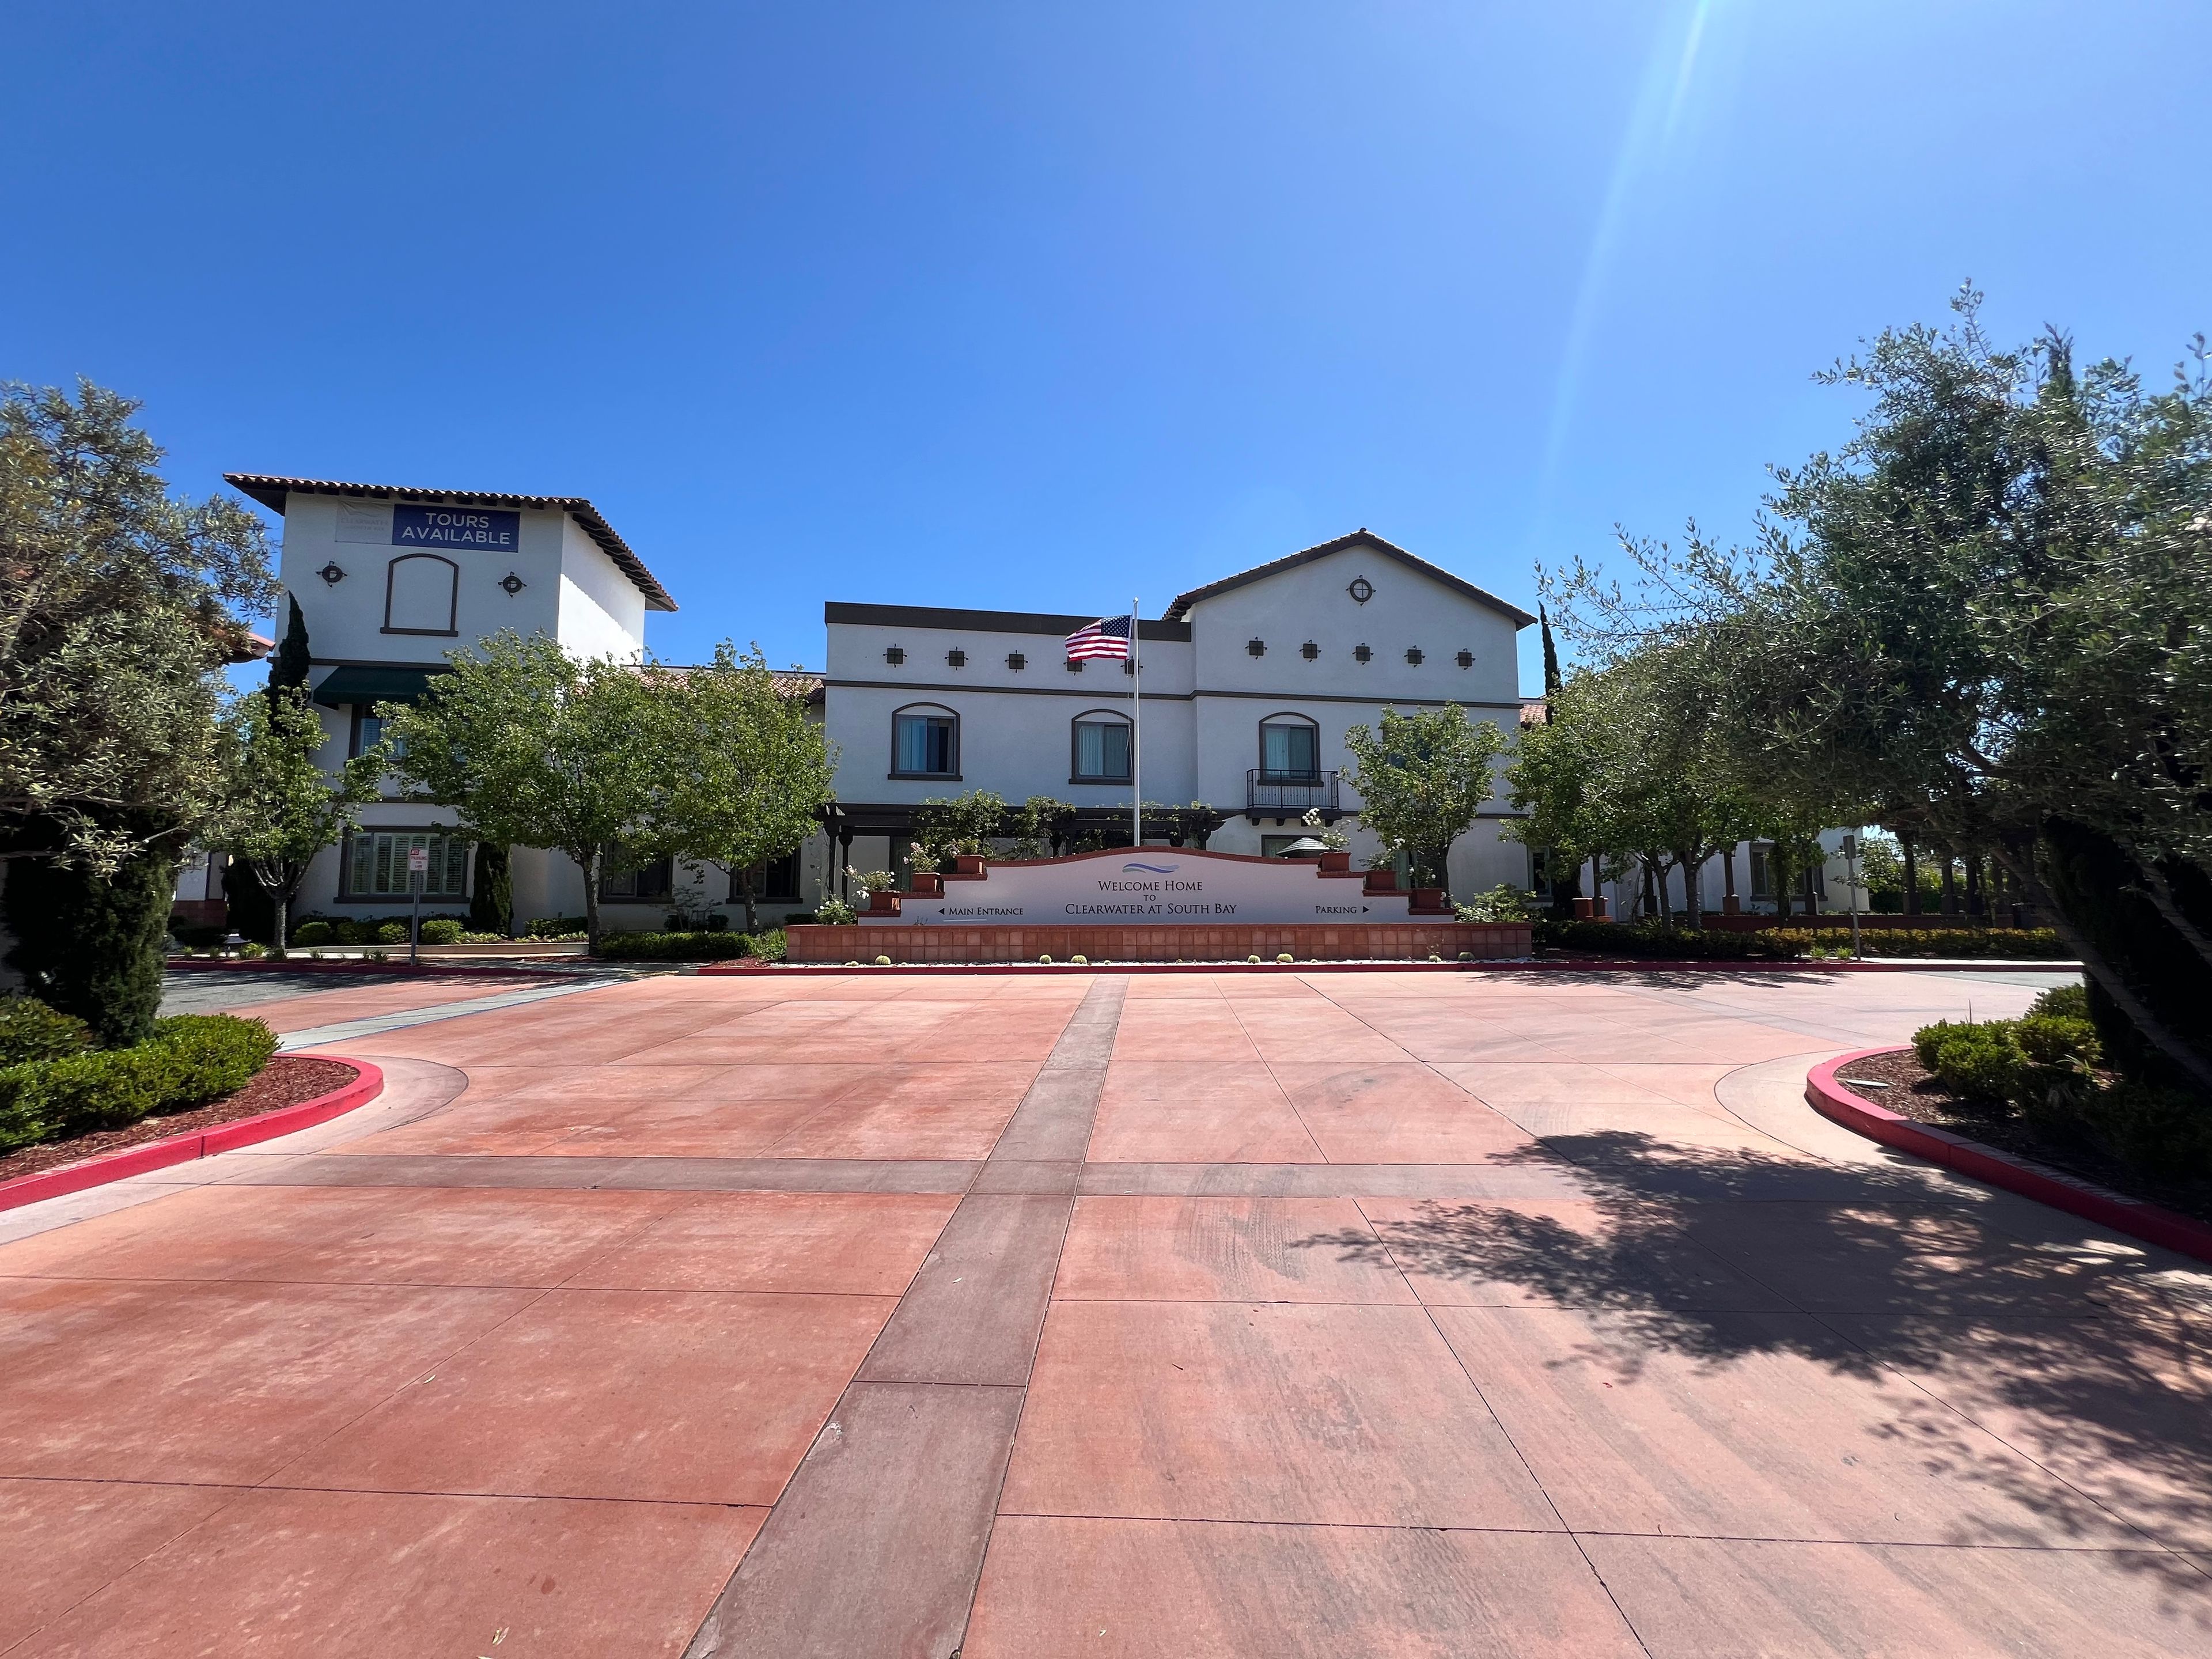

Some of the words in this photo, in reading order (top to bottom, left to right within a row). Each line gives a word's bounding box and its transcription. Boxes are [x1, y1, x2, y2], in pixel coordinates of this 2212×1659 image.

[425, 513, 489, 528] TOURS
[401, 526, 510, 544] AVAILABLE
[1098, 880, 1160, 891] WELCOME
[1165, 880, 1203, 891] HOME
[949, 907, 974, 915] MAIN
[977, 907, 1024, 915] ENTRANCE
[1065, 903, 1145, 914] CLEARWATER
[1147, 904, 1162, 914] AT
[1167, 903, 1210, 914] SOUTH
[1215, 903, 1237, 914] BAY
[1316, 906, 1357, 914] PARKING
